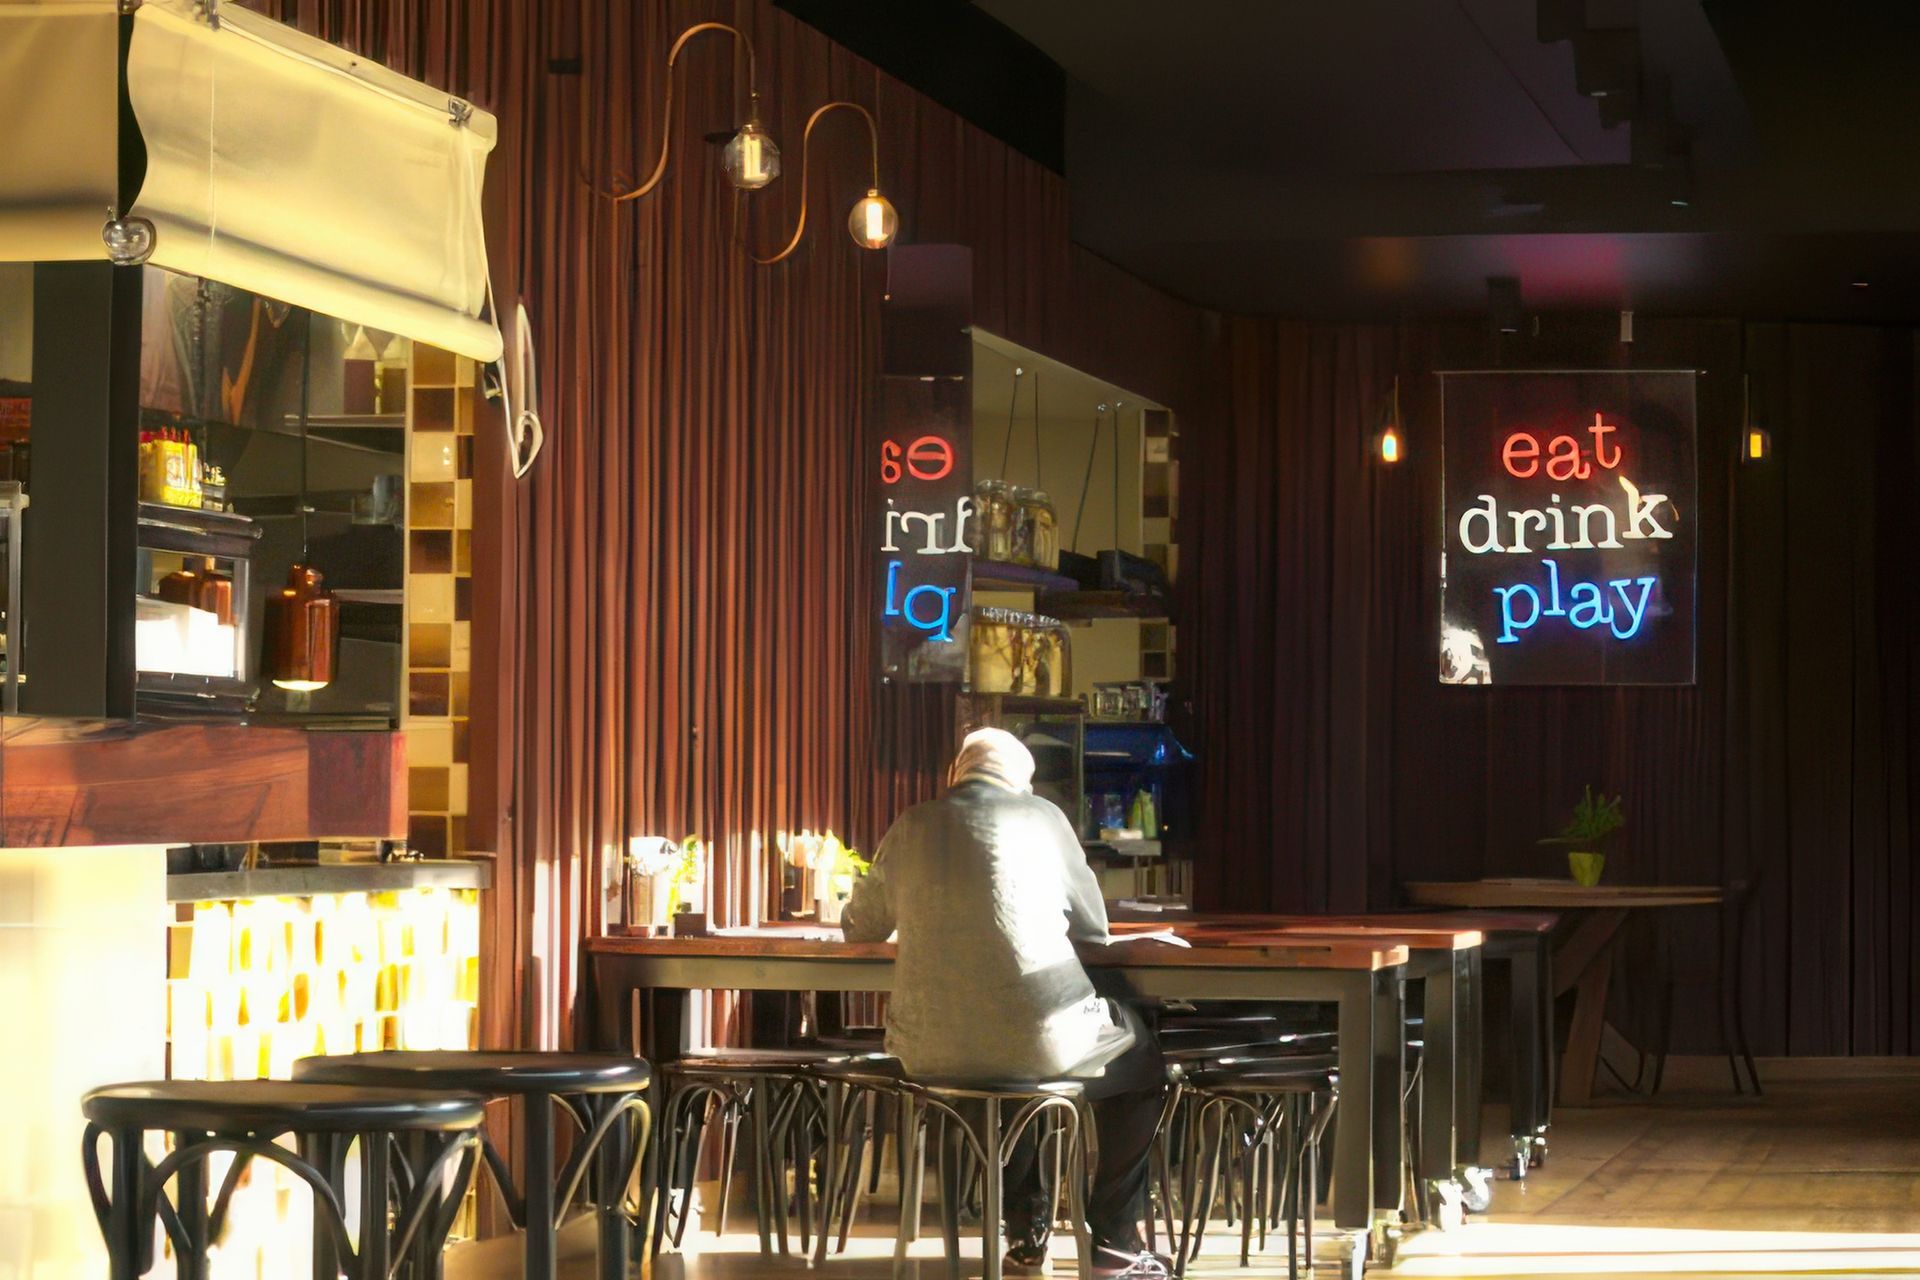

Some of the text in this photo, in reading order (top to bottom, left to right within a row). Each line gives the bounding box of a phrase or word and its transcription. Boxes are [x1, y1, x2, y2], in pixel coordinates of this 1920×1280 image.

[1502, 412, 1622, 481] eat
[1458, 475, 1674, 554] drink
[1493, 559, 1657, 643] play
